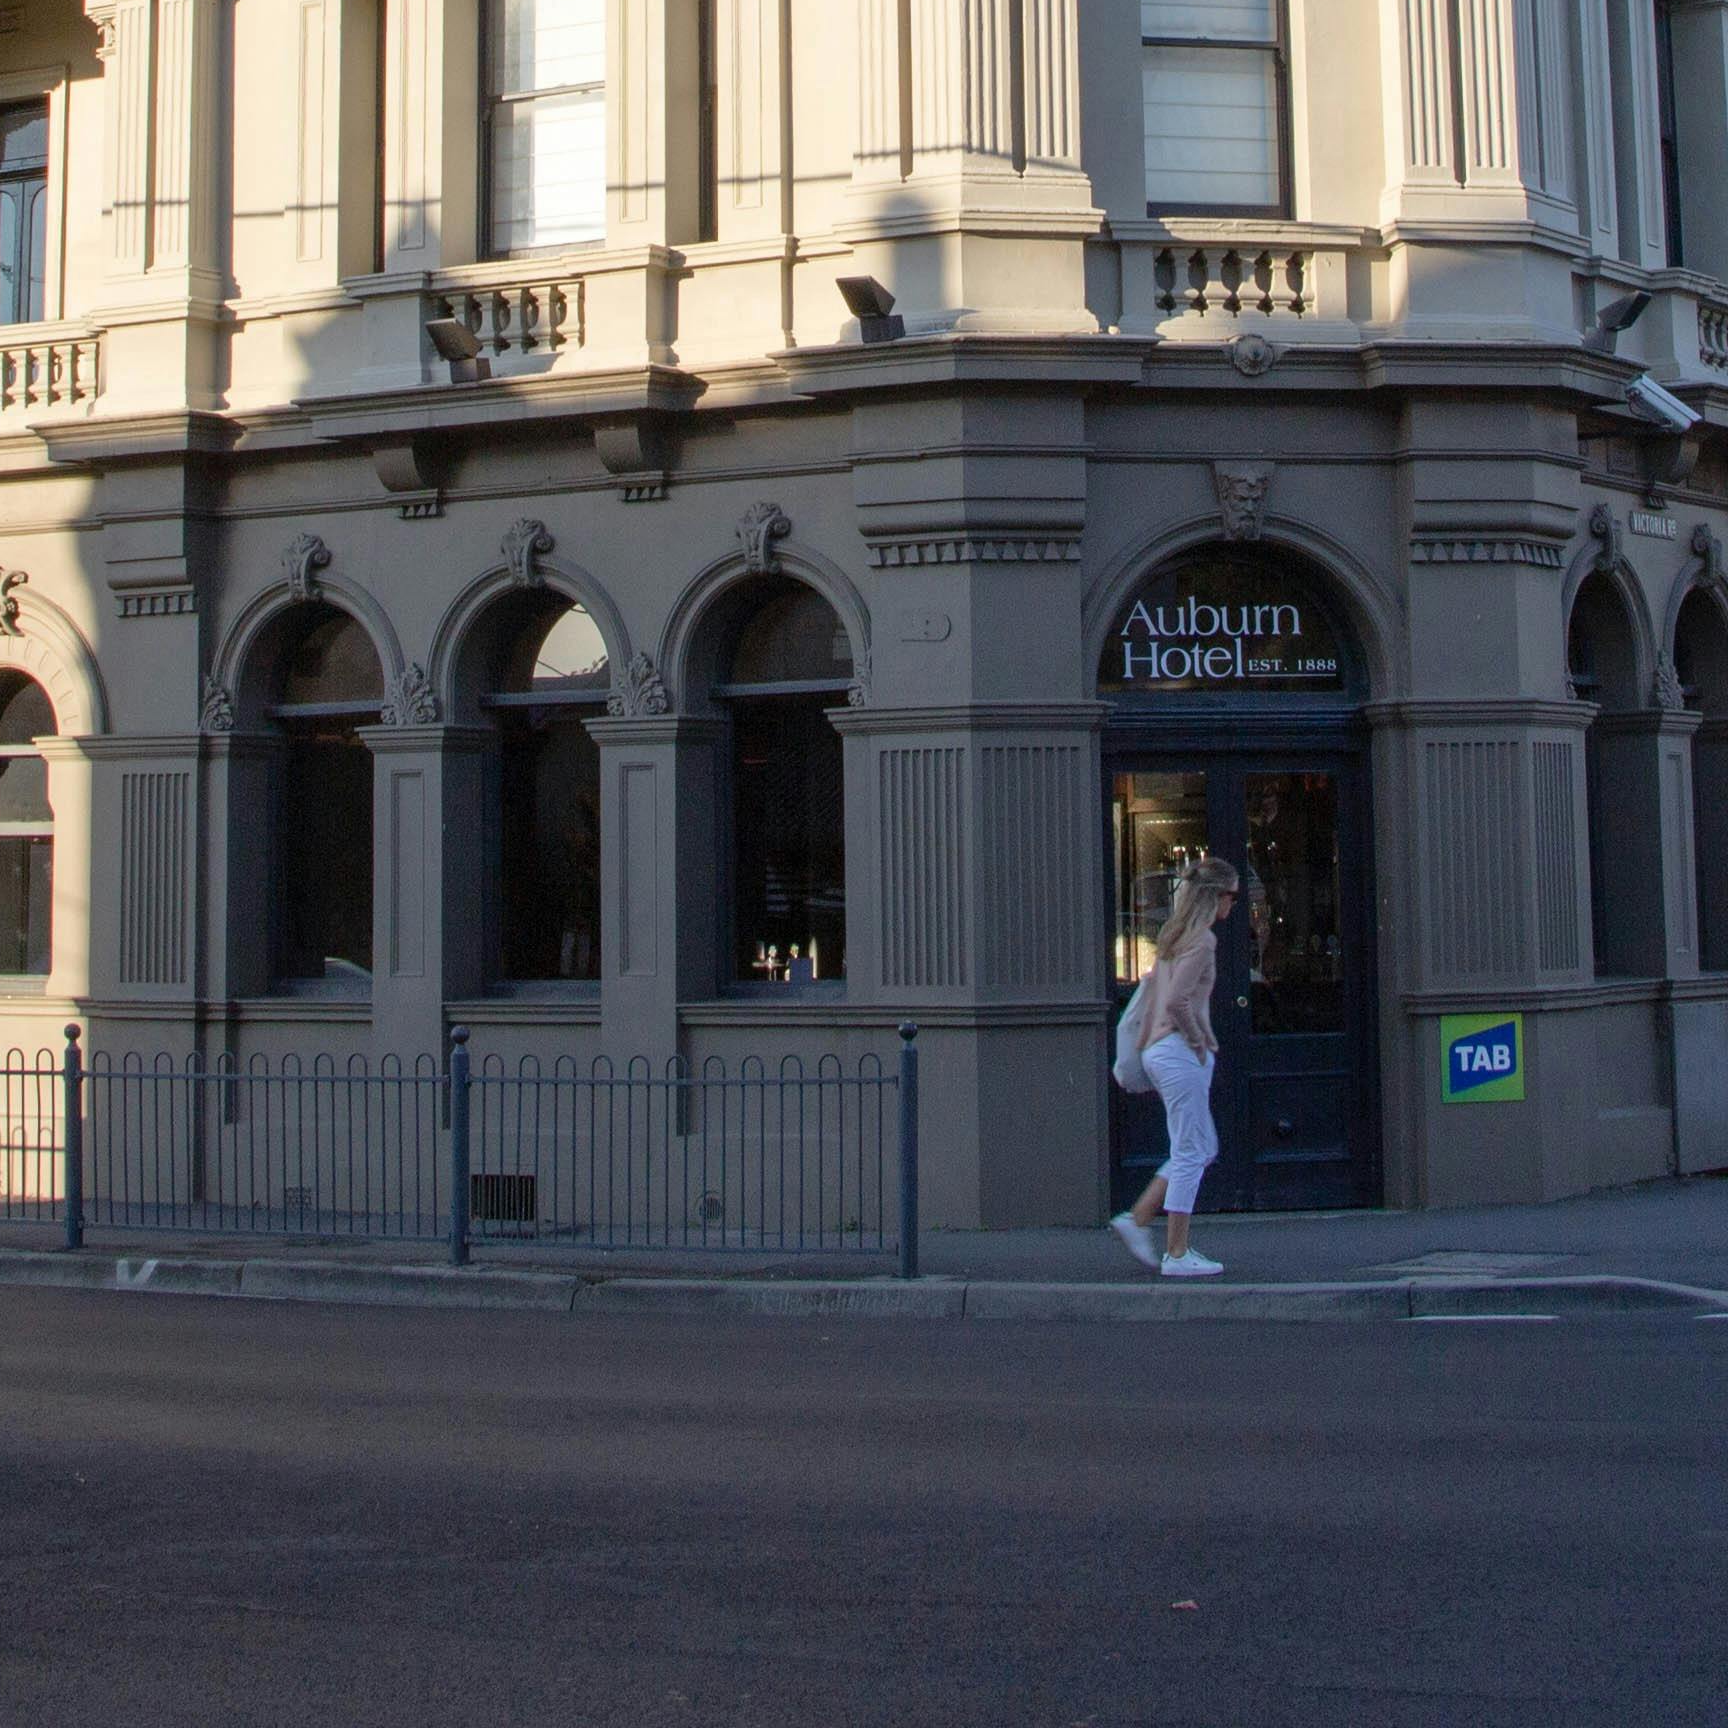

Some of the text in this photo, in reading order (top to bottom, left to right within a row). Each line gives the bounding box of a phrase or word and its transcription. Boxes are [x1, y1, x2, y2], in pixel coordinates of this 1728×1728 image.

[1633, 512, 1667, 536] VICTORIA
[1120, 595, 1302, 637] Auburn
[1122, 637, 1338, 679] Hotel EST. 1888
[1455, 1044, 1511, 1072] TAB
